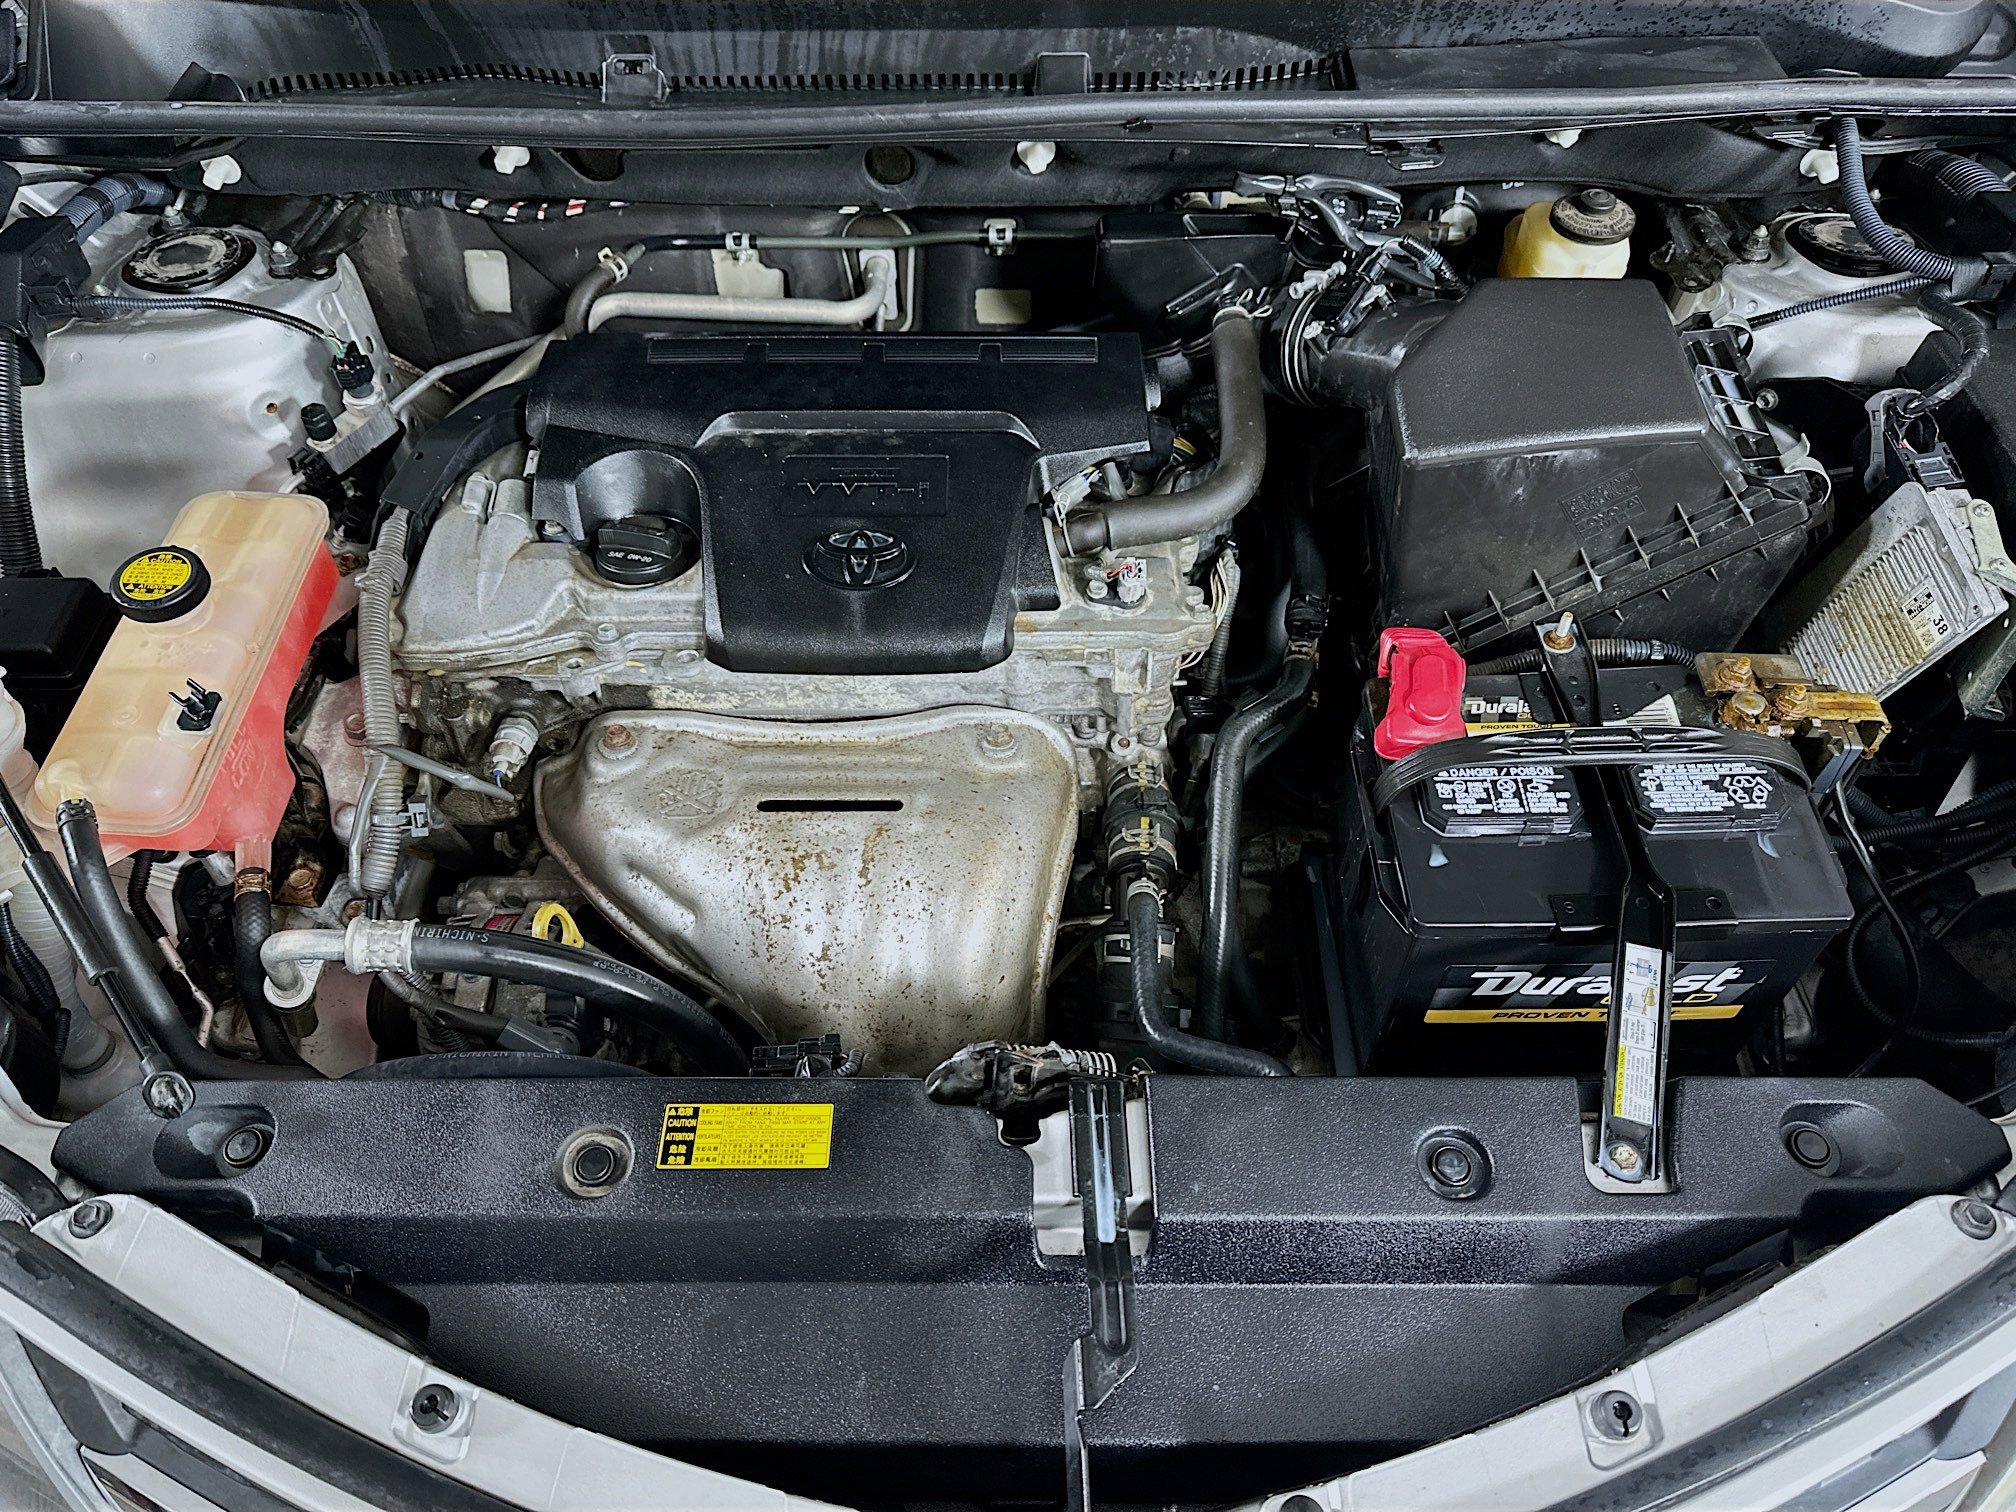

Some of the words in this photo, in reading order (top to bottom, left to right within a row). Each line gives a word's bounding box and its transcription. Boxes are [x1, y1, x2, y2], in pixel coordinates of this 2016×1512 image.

[627, 553, 653, 563] 0W-20
[1933, 614, 1949, 635] 38
[1465, 699, 1531, 714] Dural
[1449, 767, 1499, 777] DANGER
[1509, 766, 1555, 776] POISON
[1471, 967, 1741, 995] Durast
[1491, 1011, 1590, 1020] PROVEN
[668, 1118, 698, 1128] CAUTION
[665, 1132, 695, 1141] ATTENTION
